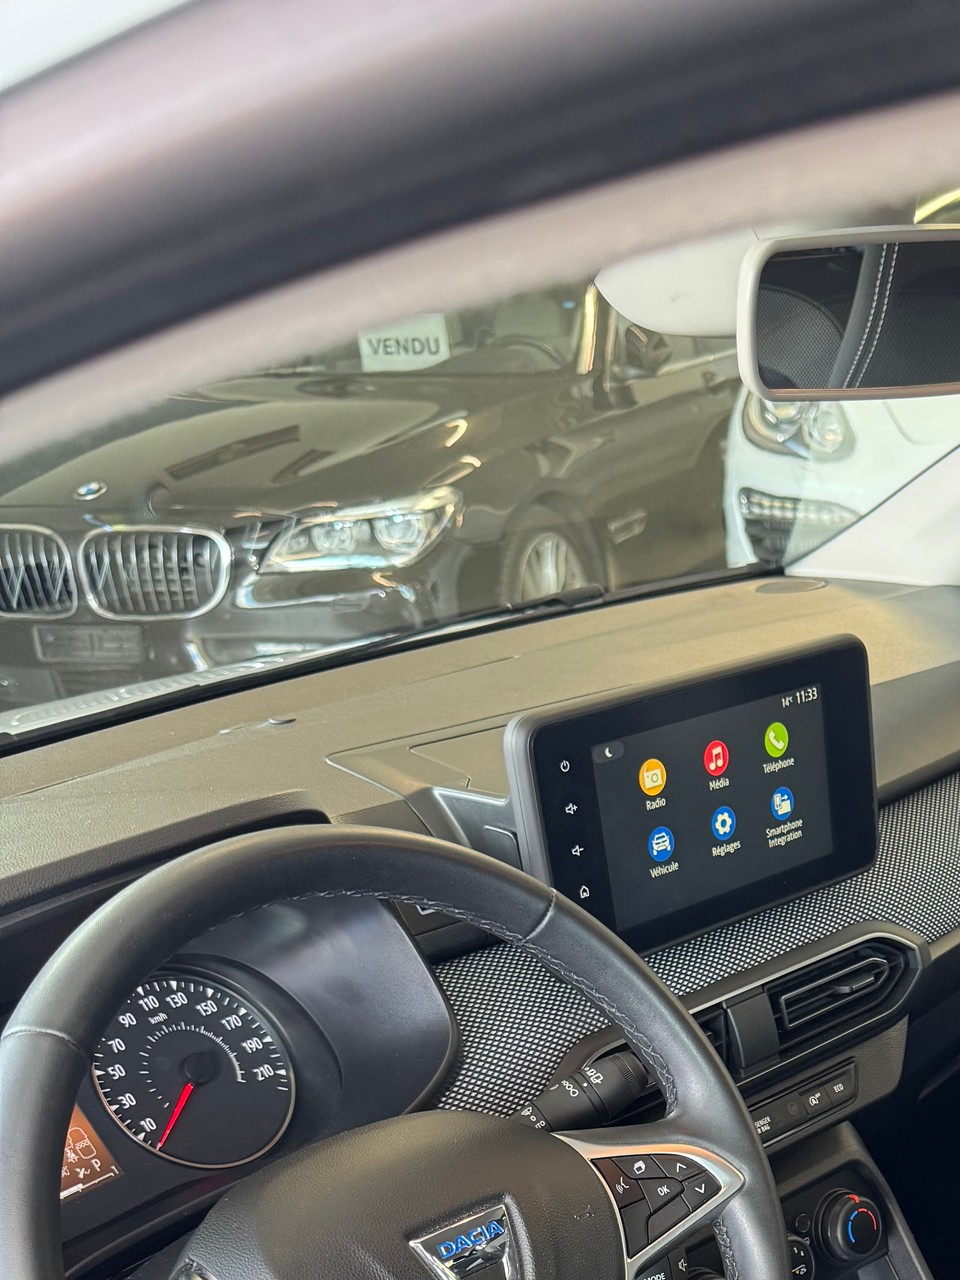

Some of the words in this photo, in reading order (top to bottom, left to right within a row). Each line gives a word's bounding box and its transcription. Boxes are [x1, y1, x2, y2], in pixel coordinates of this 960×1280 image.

[366, 336, 441, 356] VENDU
[796, 686, 818, 704] 11:33
[763, 756, 795, 774] Téléphone
[709, 776, 730, 792] Média
[646, 796, 667, 811] Radio
[766, 818, 803, 840] Smartphone
[768, 829, 803, 848] Integration
[712, 840, 742, 858] Réglages
[649, 860, 680, 878] Véhicule
[138, 995, 160, 1012] 110
[166, 992, 188, 1008] 130
[195, 1000, 218, 1017] 150
[118, 1012, 137, 1028] 90
[149, 1012, 168, 1026] km/h
[220, 1014, 243, 1031] 170
[107, 1038, 126, 1053] 70
[241, 1036, 263, 1054] 190
[107, 1064, 126, 1080] 50
[253, 1064, 275, 1081] 210
[833, 1083, 844, 1093] ECO
[118, 1093, 137, 1110] 30
[140, 1117, 157, 1132] 10
[91, 1158, 101, 1172] P
[657, 1185, 670, 1196] OK
[436, 1219, 505, 1260] DACIA
